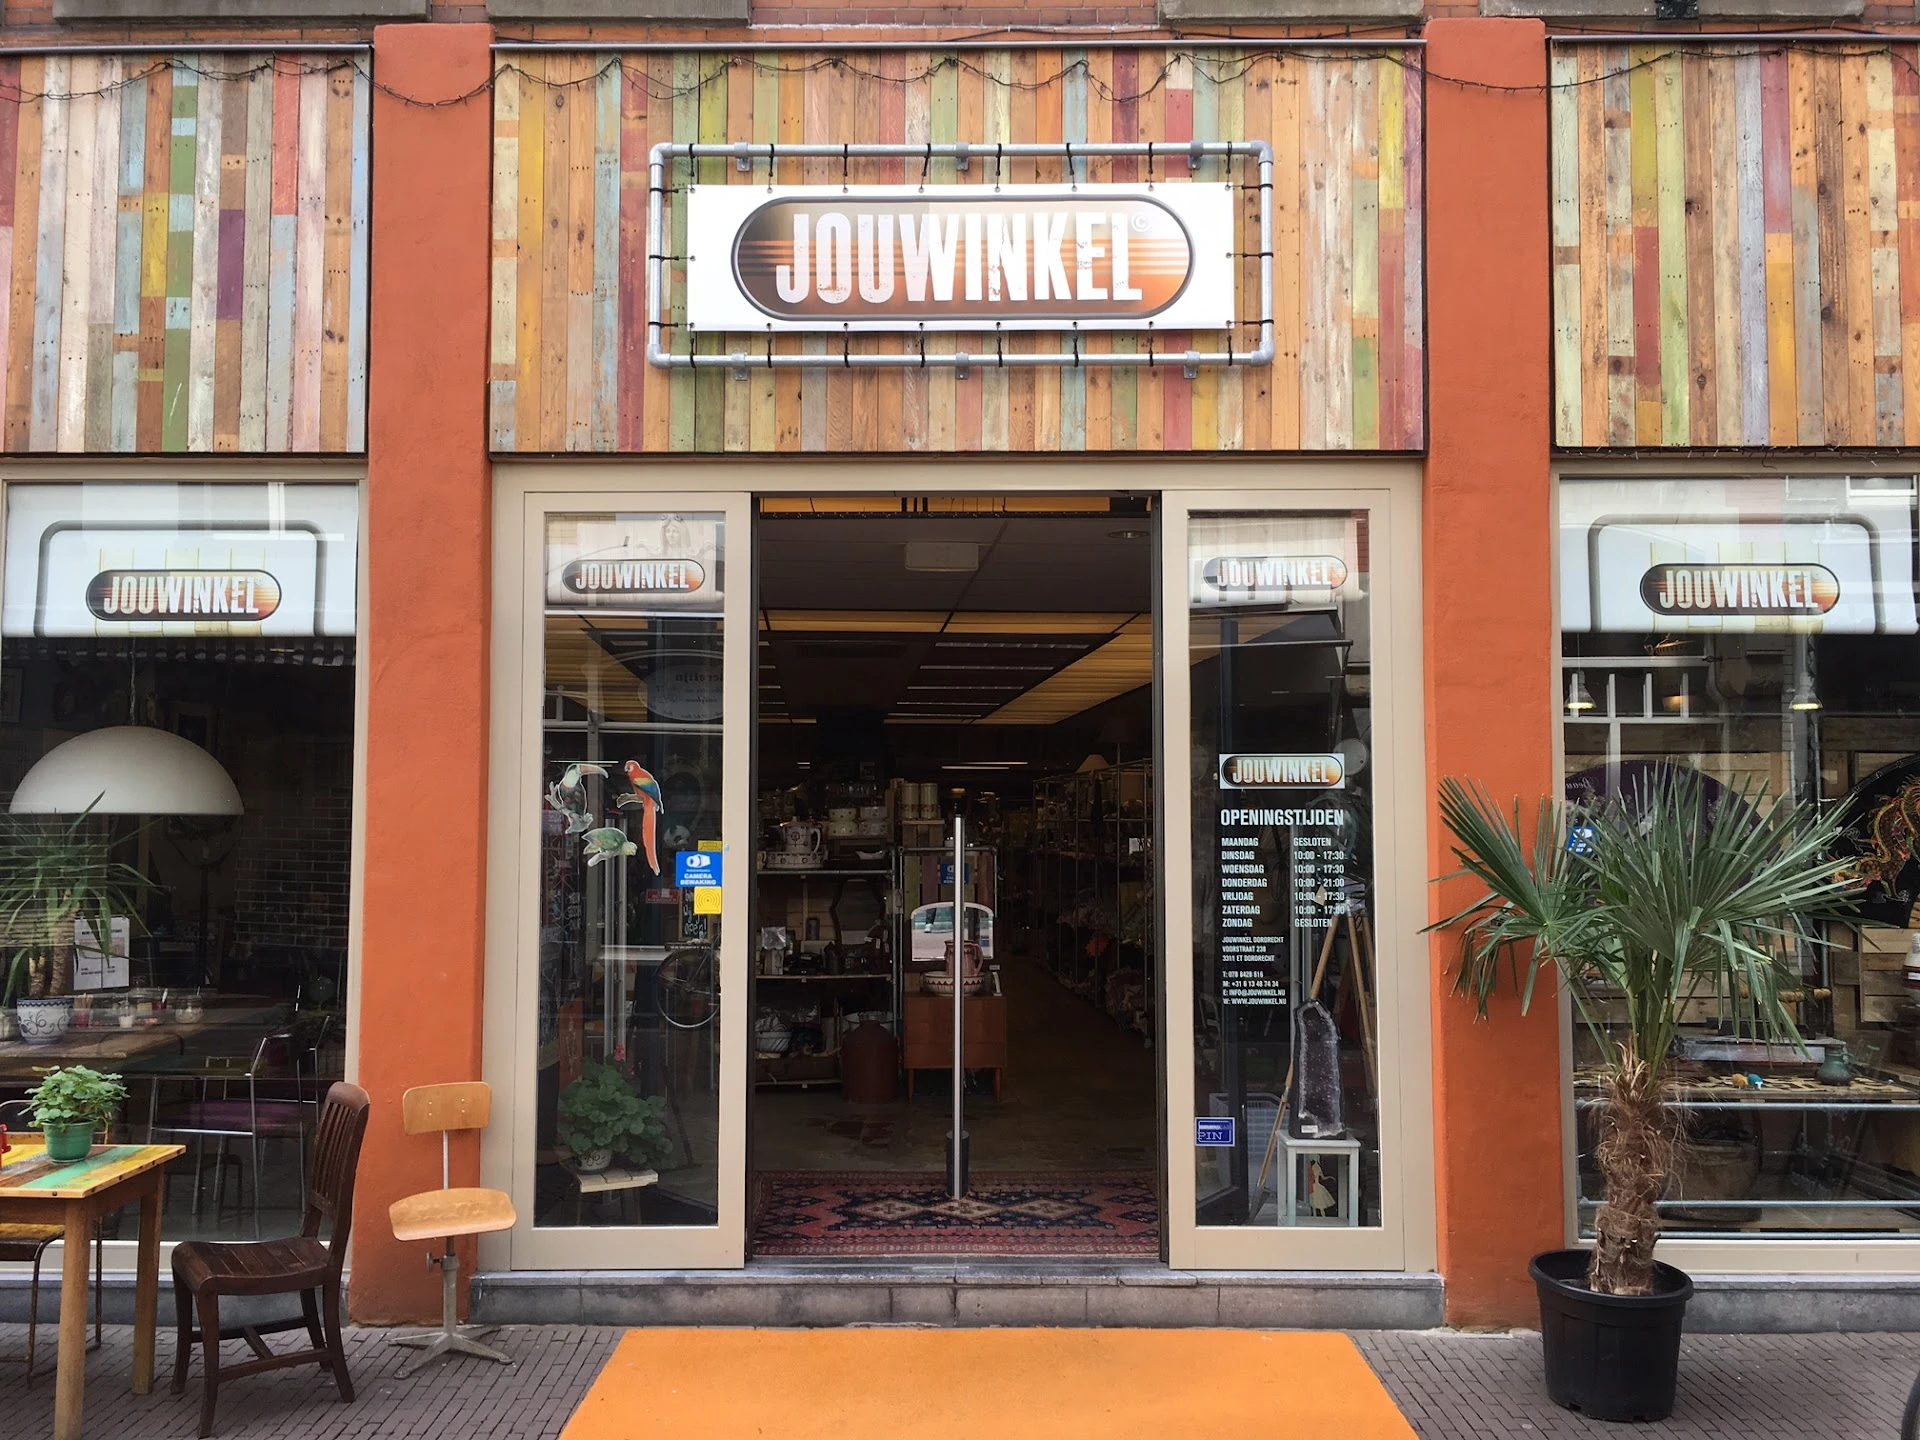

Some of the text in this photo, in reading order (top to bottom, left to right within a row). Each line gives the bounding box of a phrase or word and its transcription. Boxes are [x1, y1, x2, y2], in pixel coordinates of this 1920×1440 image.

[775, 211, 1143, 304] JOUWINKEL
[575, 563, 689, 589] JOUWINKEL
[1217, 560, 1332, 586] JOUWINKEL
[1659, 570, 1818, 608] JOUWINKEL
[104, 575, 259, 614] JOUWINKEL
[1232, 759, 1329, 783] JOUWINKEL
[1220, 809, 1343, 826] OPENINGSTIJDEN
[1221, 837, 1331, 847] MAANDAG GESLOTEN
[1221, 851, 1255, 860] DINSDAG
[1294, 851, 1315, 860] 10:00
[1323, 851, 1344, 860] 17:30
[1221, 864, 1264, 874] WOENSDAG
[1294, 864, 1315, 874] 10:00
[1323, 864, 1344, 874] 17:30
[1221, 878, 1267, 887] DONDERDAG
[1294, 878, 1315, 887] 10:00
[1323, 878, 1344, 887] 21:00
[1221, 892, 1253, 901] VRIJDAG
[1294, 892, 1315, 901] 10:00
[1323, 892, 1344, 901] 17:30
[1221, 905, 1260, 914] ZATERDAG
[1295, 905, 1315, 914] 10:00
[1323, 905, 1344, 914] 17:00
[1222, 918, 1332, 927] ZONDAG GESLOTEN
[1197, 1131, 1223, 1140] PIN
